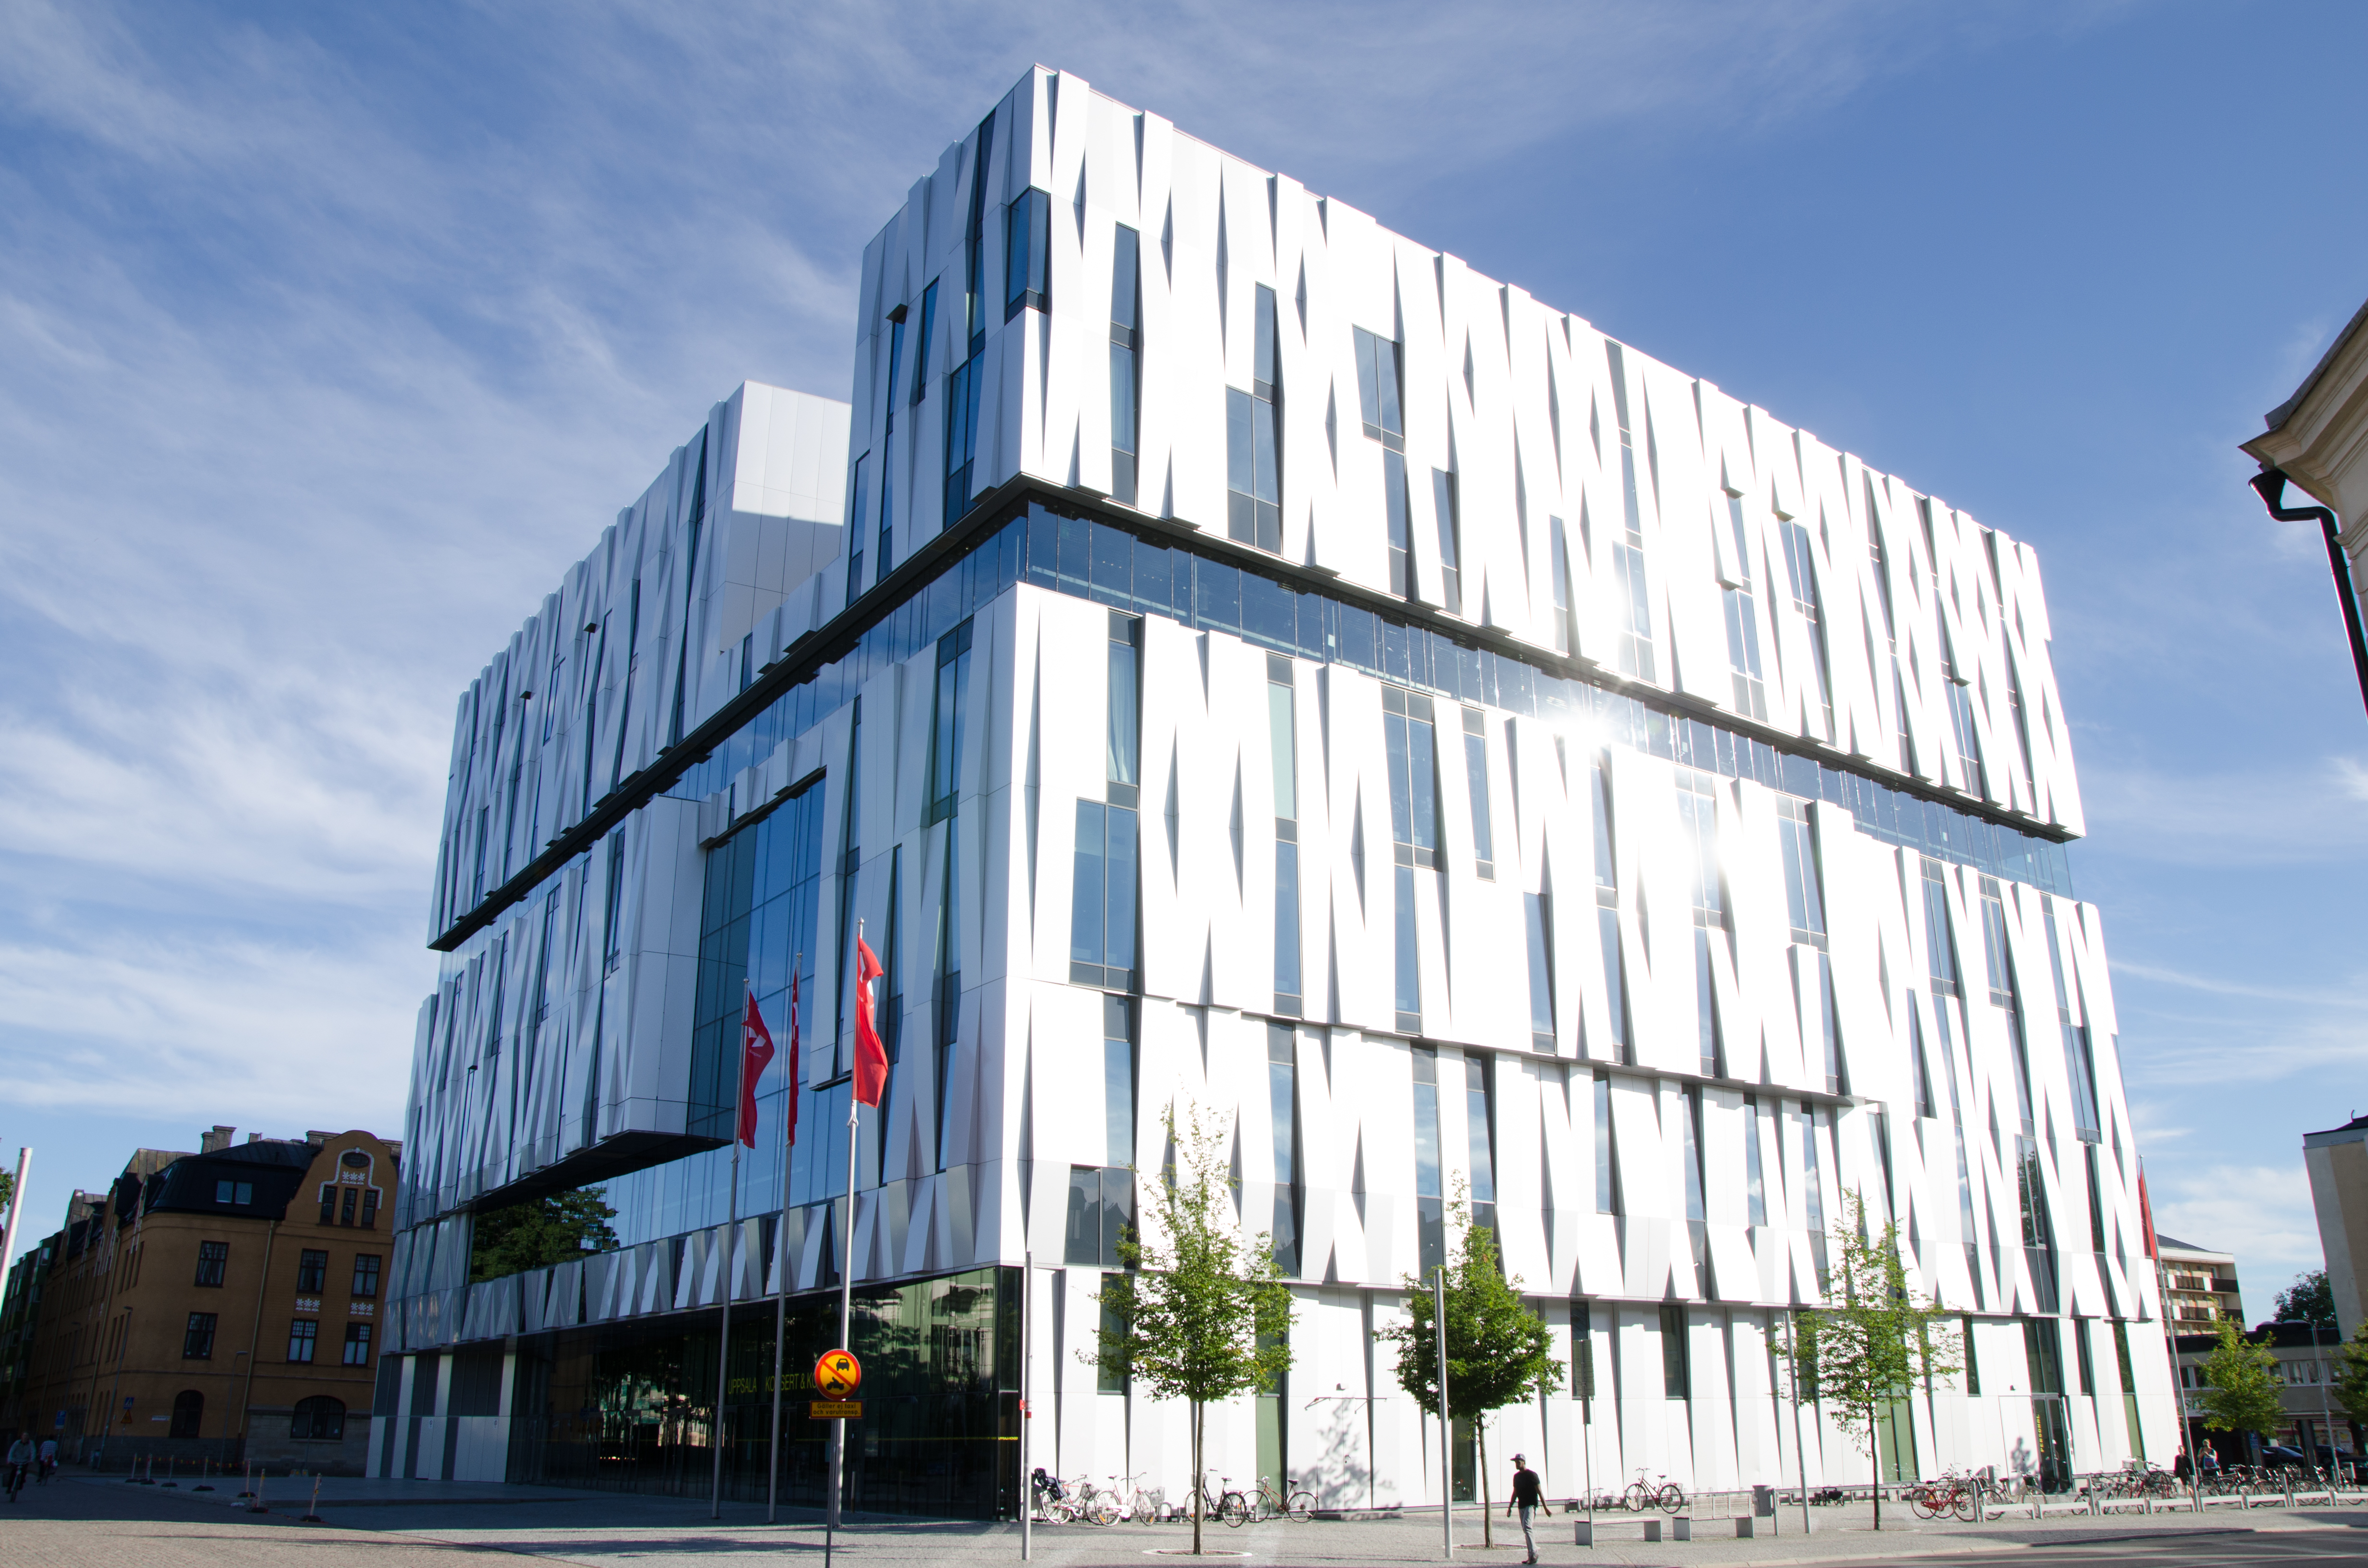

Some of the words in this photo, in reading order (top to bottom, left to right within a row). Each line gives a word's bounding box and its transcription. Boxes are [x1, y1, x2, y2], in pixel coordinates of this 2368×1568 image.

[728, 1377, 757, 1394] UPPSALA
[765, 1374, 799, 1392] KOSERT
[800, 1373, 805, 1389] &
[2036, 1414, 2045, 1453] PERSONAL
